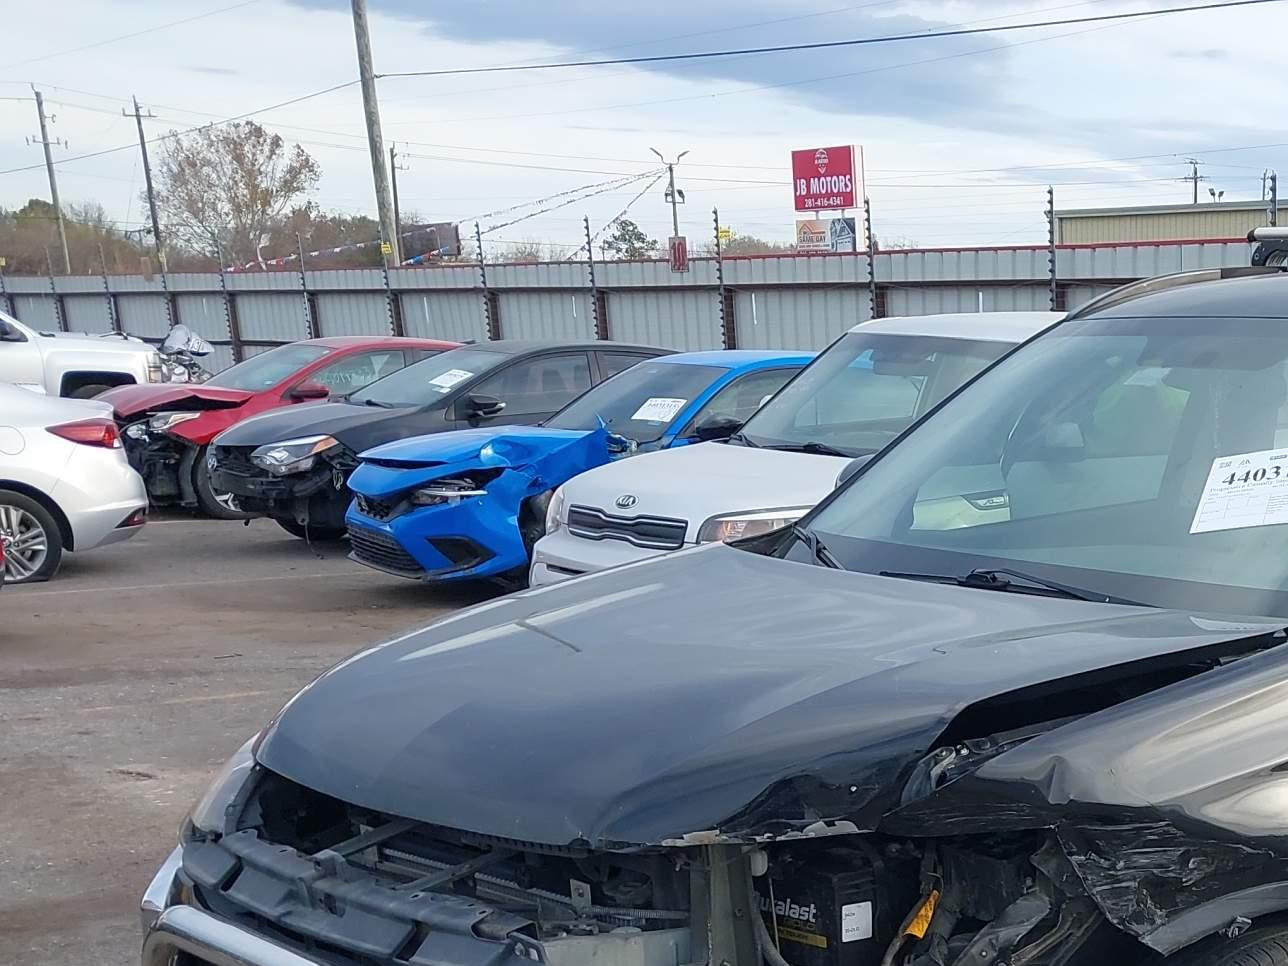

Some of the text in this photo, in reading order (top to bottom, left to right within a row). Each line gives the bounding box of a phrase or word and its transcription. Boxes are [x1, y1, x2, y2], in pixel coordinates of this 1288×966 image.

[796, 175, 851, 196] JB MOTORS
[804, 196, 844, 208] 281-416-4341
[617, 495, 634, 506] KIA
